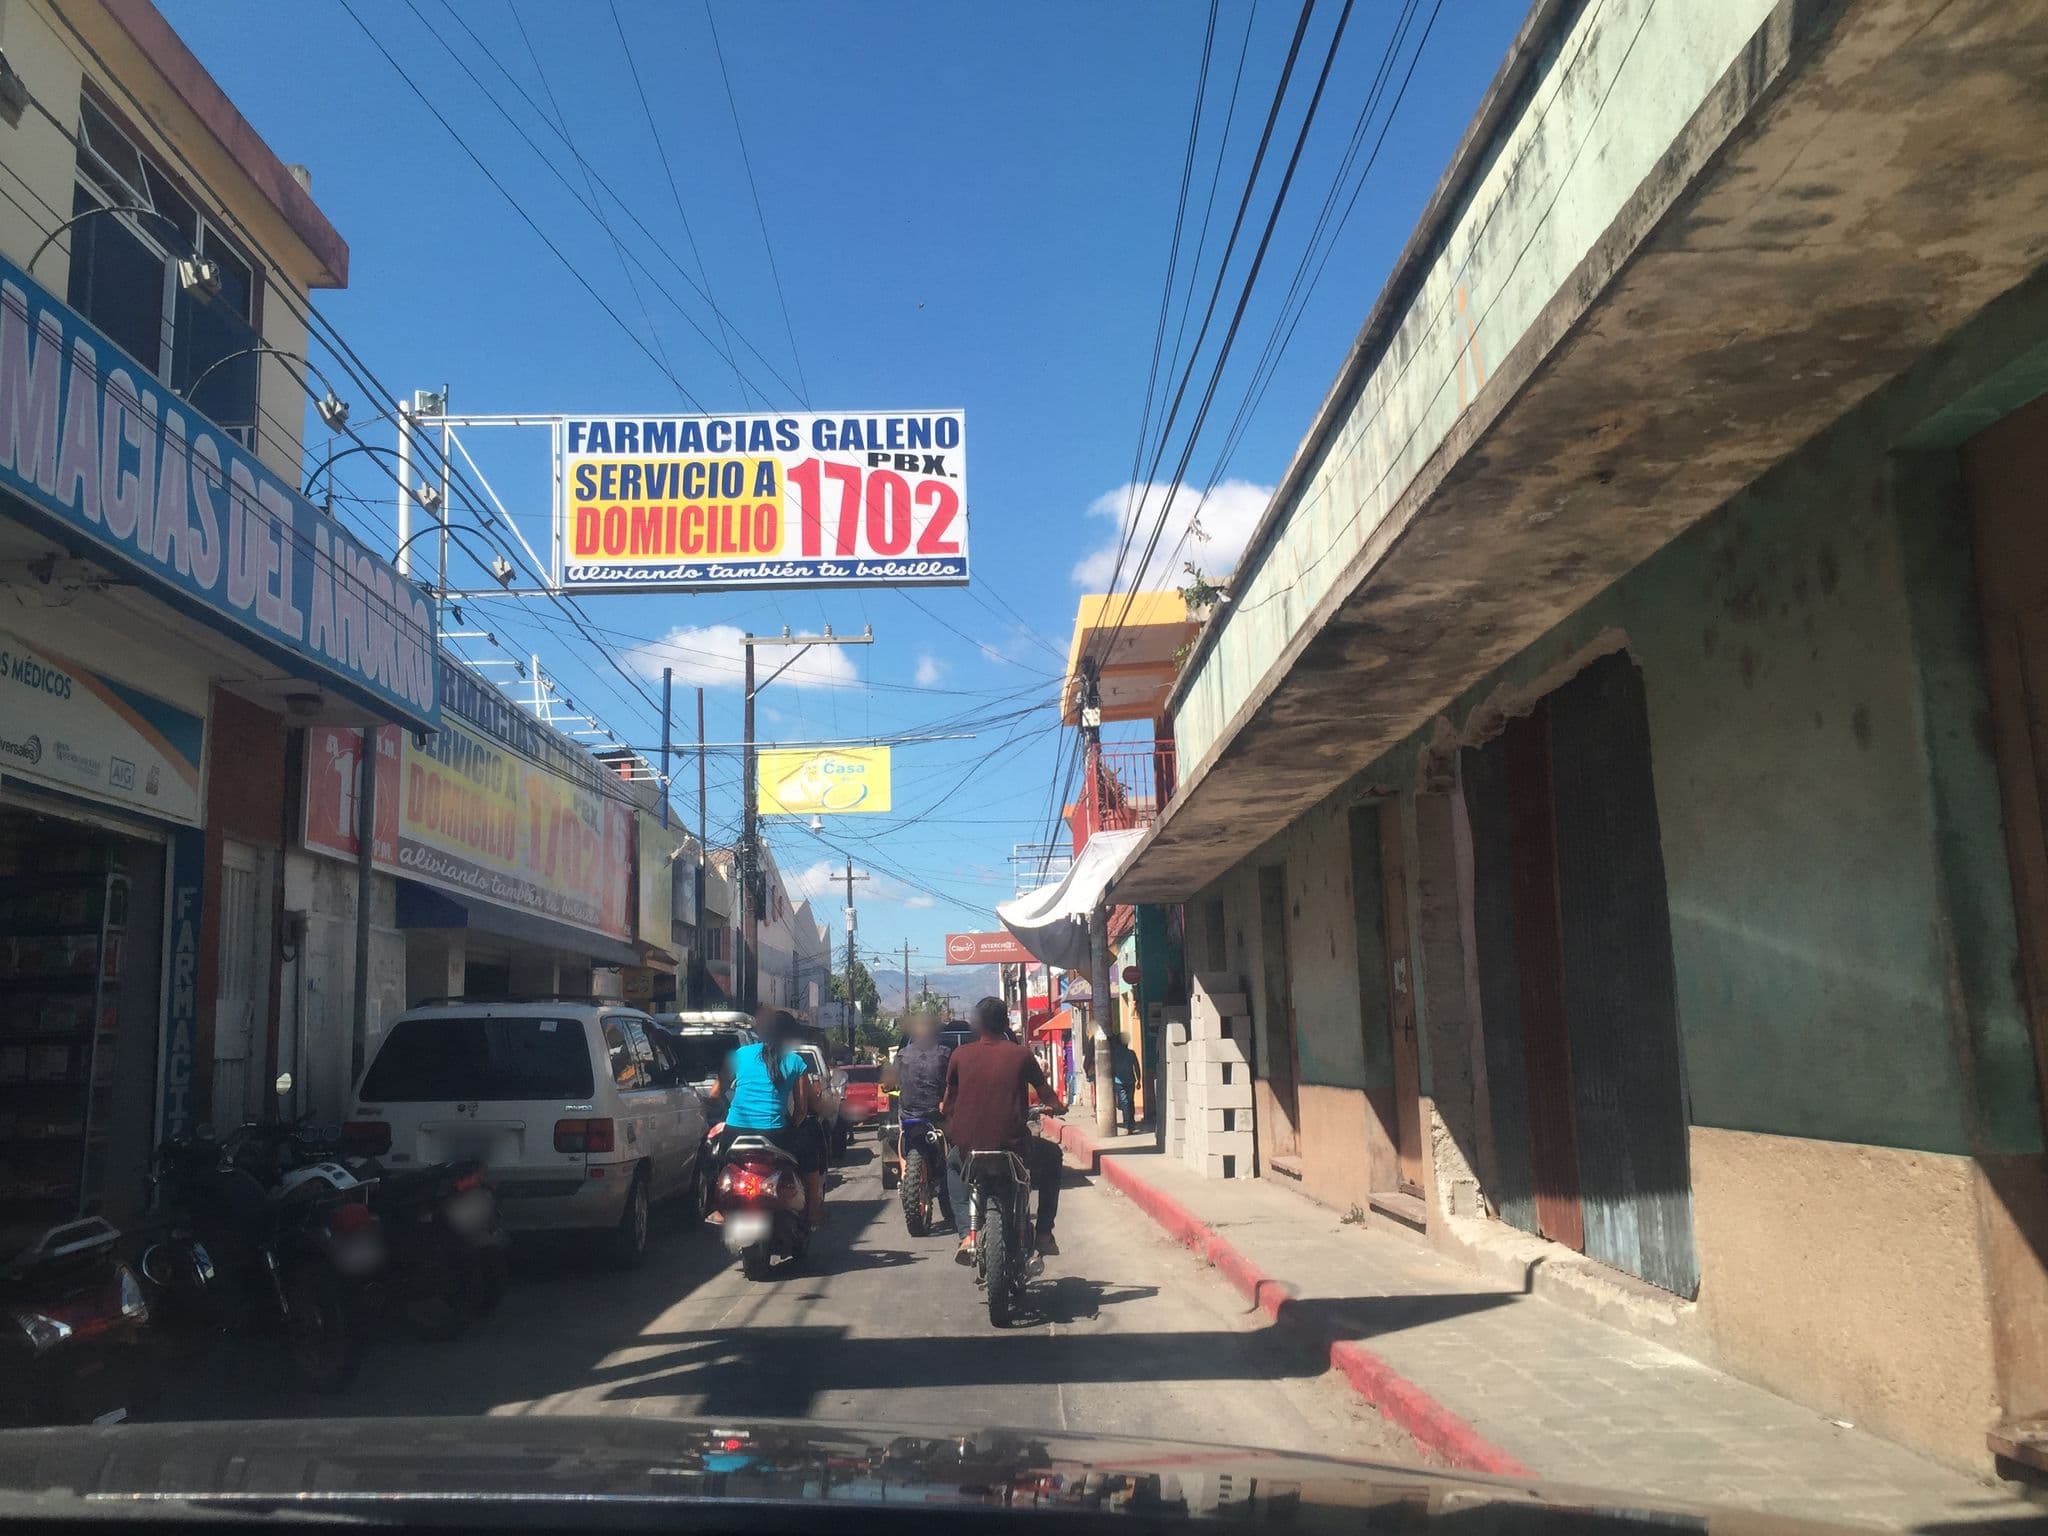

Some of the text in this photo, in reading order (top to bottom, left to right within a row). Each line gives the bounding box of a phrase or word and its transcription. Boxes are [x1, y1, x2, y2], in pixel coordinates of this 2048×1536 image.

[568, 416, 960, 454] FARMACIAS GALENO
[575, 460, 776, 501] SERVICIO A
[867, 452, 958, 478] PBX.
[1, 279, 433, 713] MACIAS DEL AHORRO
[787, 457, 960, 557] 1702
[575, 503, 778, 556] DOMICILIO
[706, 560, 813, 578] también
[817, 562, 851, 577] tu
[855, 559, 961, 577] bolsillo
[11, 655, 72, 700] MÉDICOS
[112, 765, 132, 785] AIG
[823, 762, 865, 775] Casa
[407, 761, 517, 861] DOMICILIO
[951, 945, 970, 953] Claro
